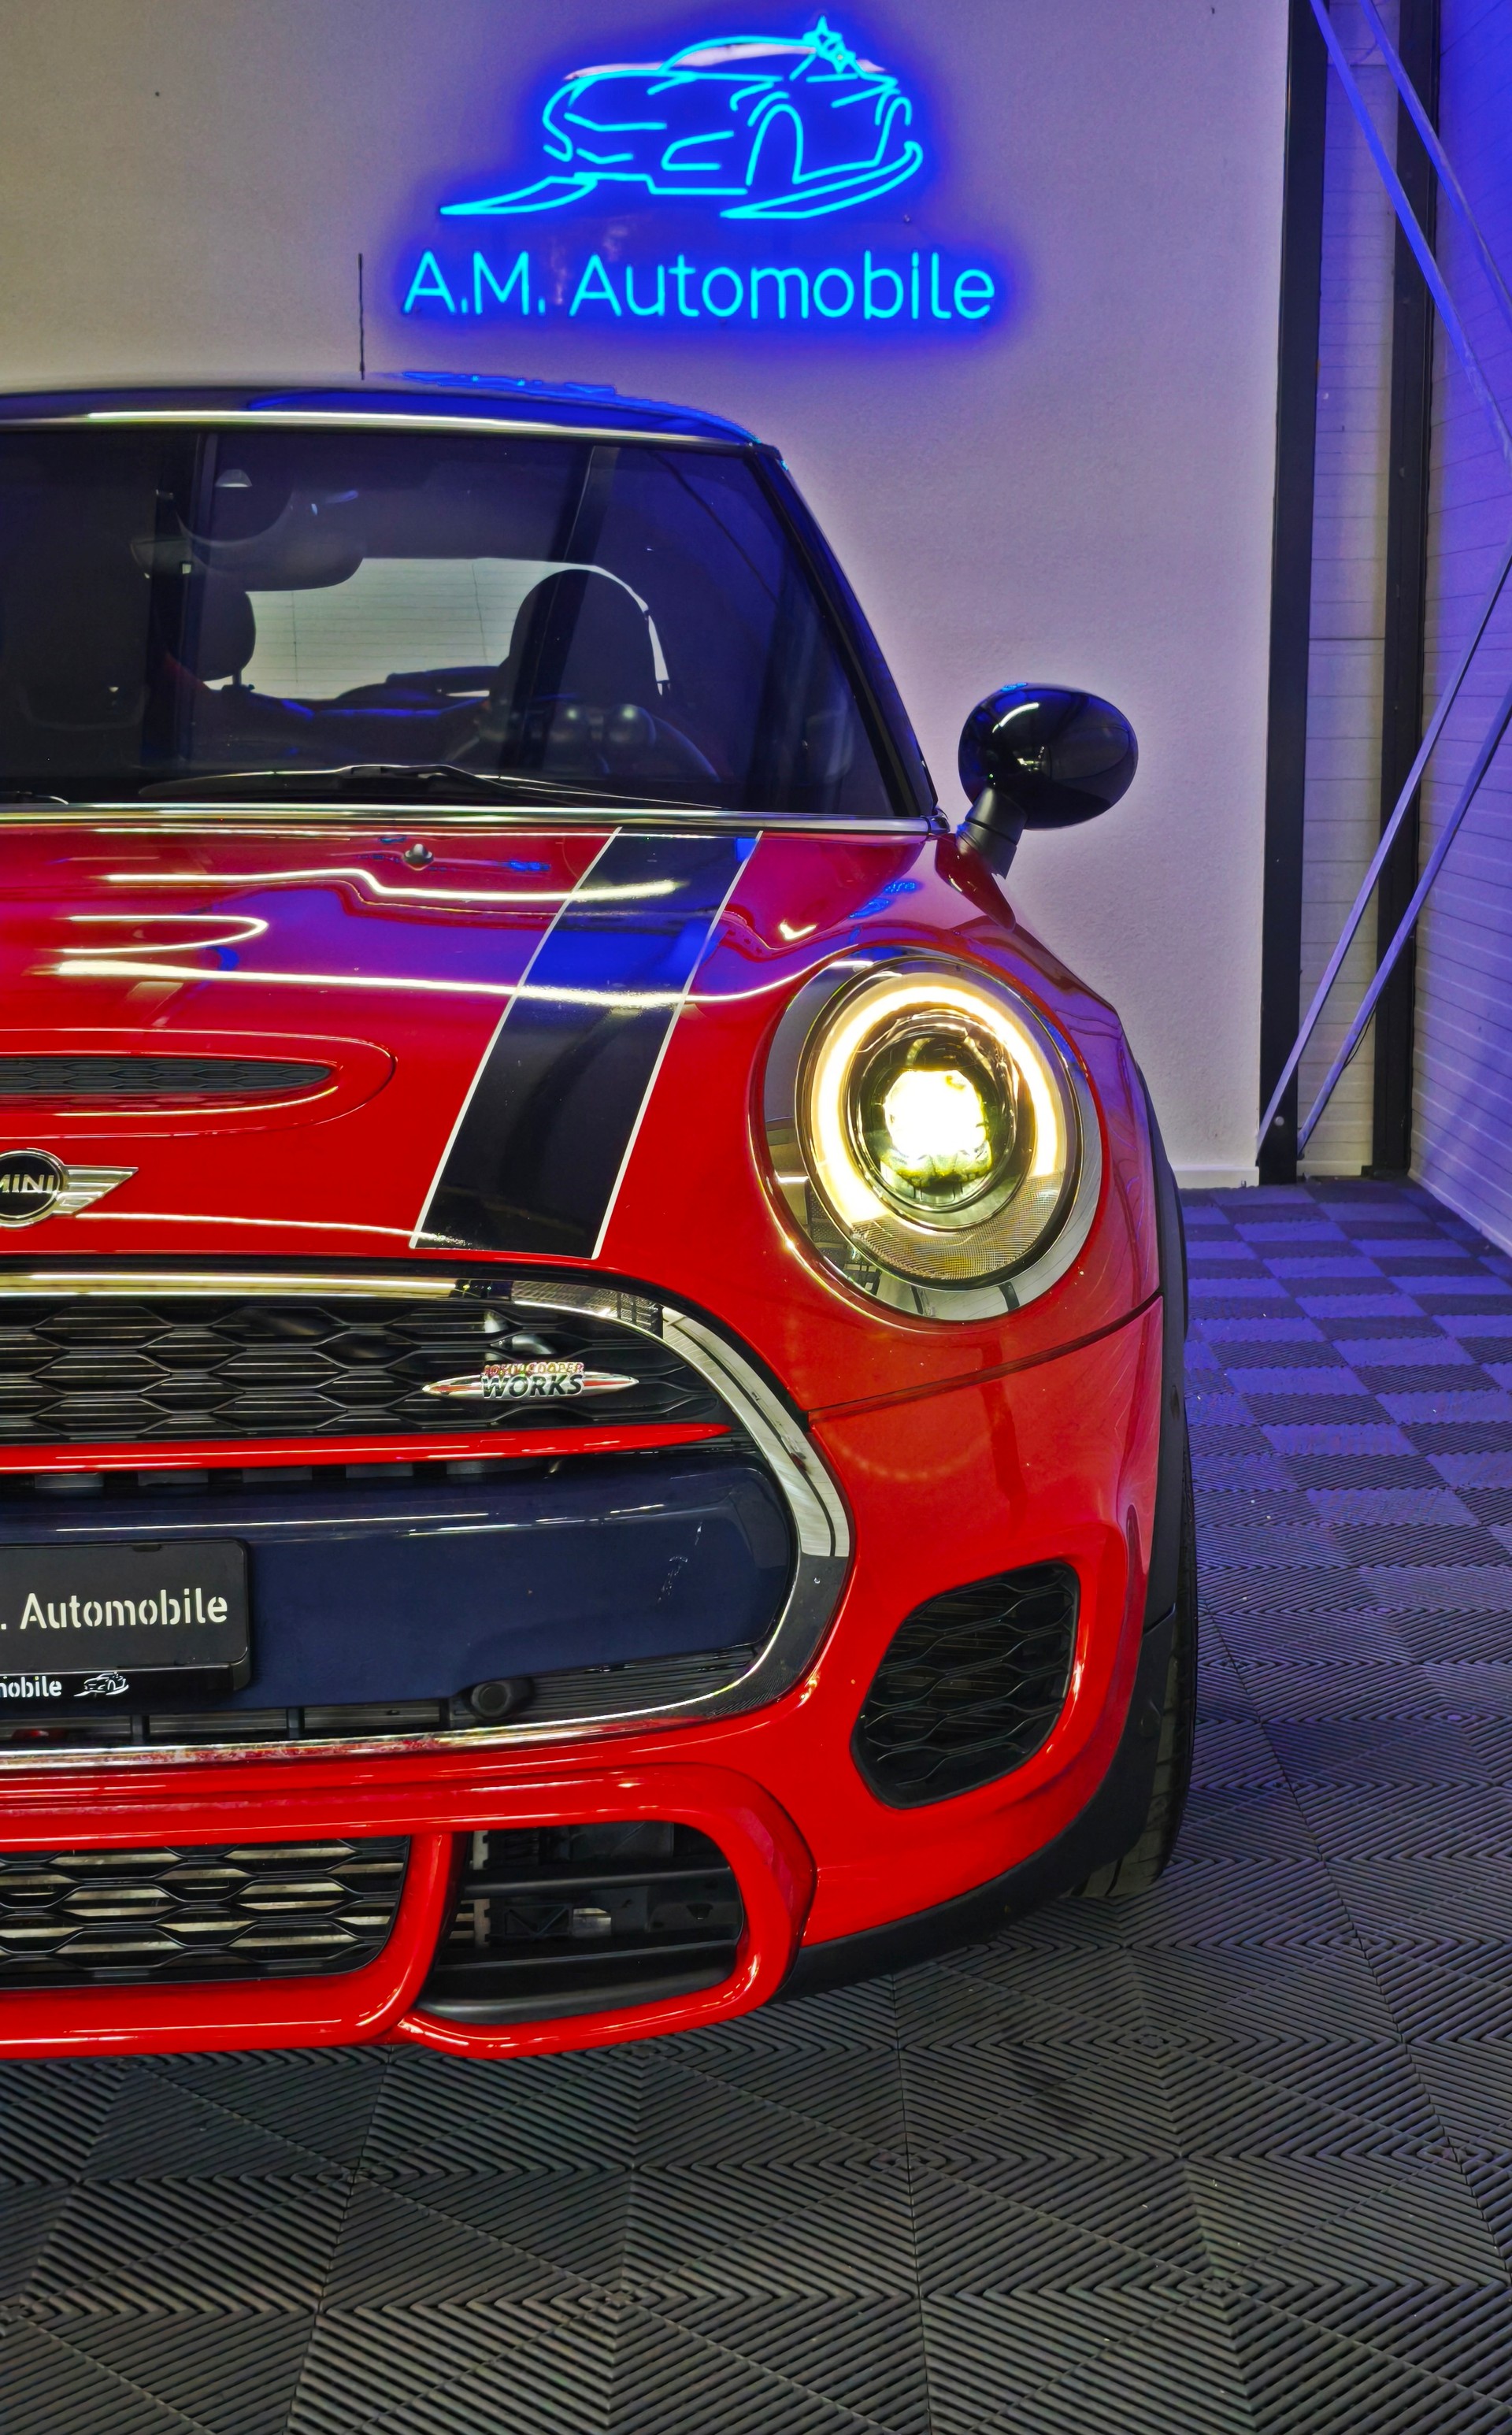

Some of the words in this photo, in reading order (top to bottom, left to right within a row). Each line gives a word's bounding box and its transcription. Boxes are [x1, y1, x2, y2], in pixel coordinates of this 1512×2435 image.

[402, 250, 546, 315] A.M.
[569, 250, 996, 321] Automobile
[480, 1373, 584, 1399] WORKS
[20, 1588, 228, 1630] Automobile
